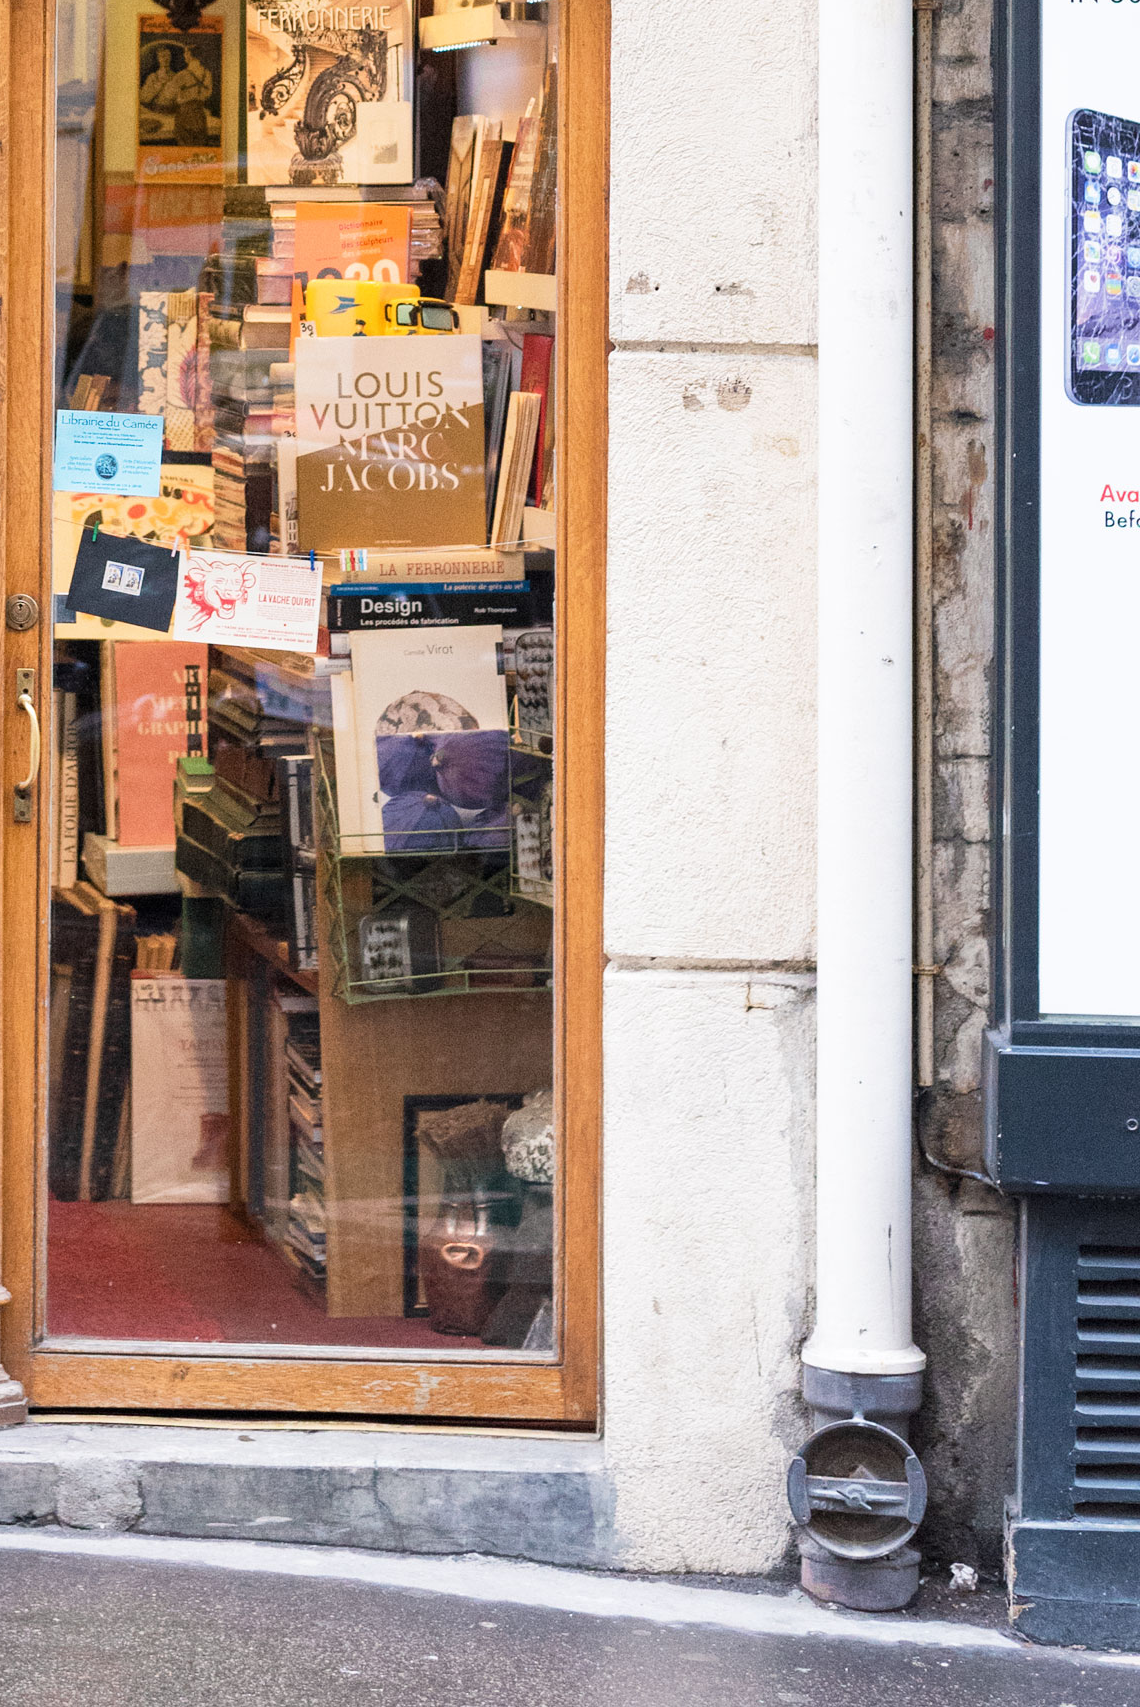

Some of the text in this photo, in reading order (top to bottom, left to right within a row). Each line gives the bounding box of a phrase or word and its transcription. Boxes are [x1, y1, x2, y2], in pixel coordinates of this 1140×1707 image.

[257, 5, 392, 33] FERRONNERIE
[339, 219, 383, 231] Dictionnaire
[342, 237, 394, 249] des sculpteurs
[338, 371, 444, 399] LOUIS
[61, 413, 159, 430] Librairie du Camée
[310, 401, 471, 431] VUITTON
[339, 431, 445, 460] MARC
[320, 462, 460, 493] JACOBS
[379, 560, 506, 577] LA FERRONNERIE
[478, 583, 488, 591] de
[258, 595, 316, 607] LA VACHE QUI RIT
[360, 598, 423, 618] Design
[360, 618, 374, 626] Les
[375, 617, 409, 627] procédés
[420, 617, 459, 625] fabrication
[426, 644, 454, 656] Virot
[64, 794, 77, 838] FOLIE
[64, 845, 75, 863] LA
